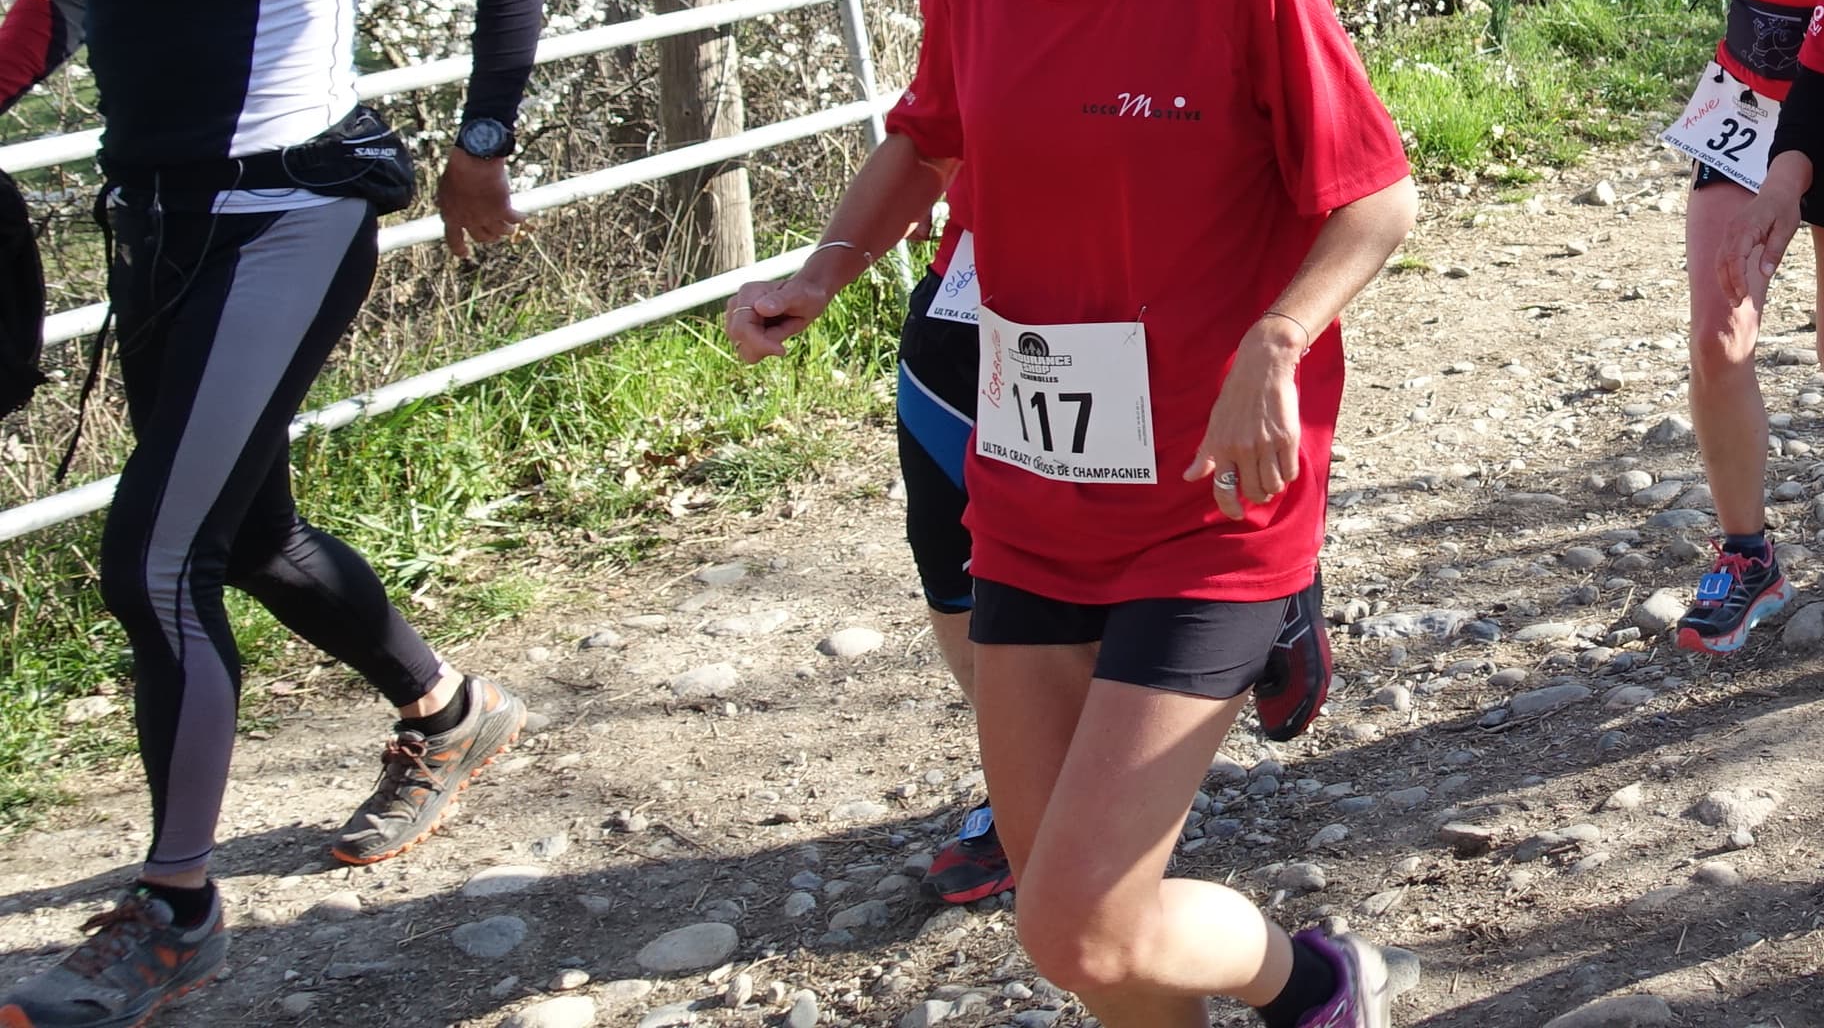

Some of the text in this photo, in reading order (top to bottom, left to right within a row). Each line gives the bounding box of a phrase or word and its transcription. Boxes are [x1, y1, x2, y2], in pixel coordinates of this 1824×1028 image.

[1083, 92, 1202, 121] LOCOMOTIVE
[1664, 134, 1683, 148] ULTRA
[1681, 143, 1699, 158] CRAZY
[1699, 151, 1716, 165] CROSS
[1714, 159, 1723, 170] DE
[1706, 117, 1758, 163] 32
[934, 307, 959, 318] ULTRA
[1008, 348, 1072, 367] ENDURANCE
[1022, 363, 1051, 375] SHOP
[1020, 372, 1059, 384] ECHIROLLES
[982, 441, 1151, 479] ULTRA CRAZY CROSS DE CHAMPAGNIER
